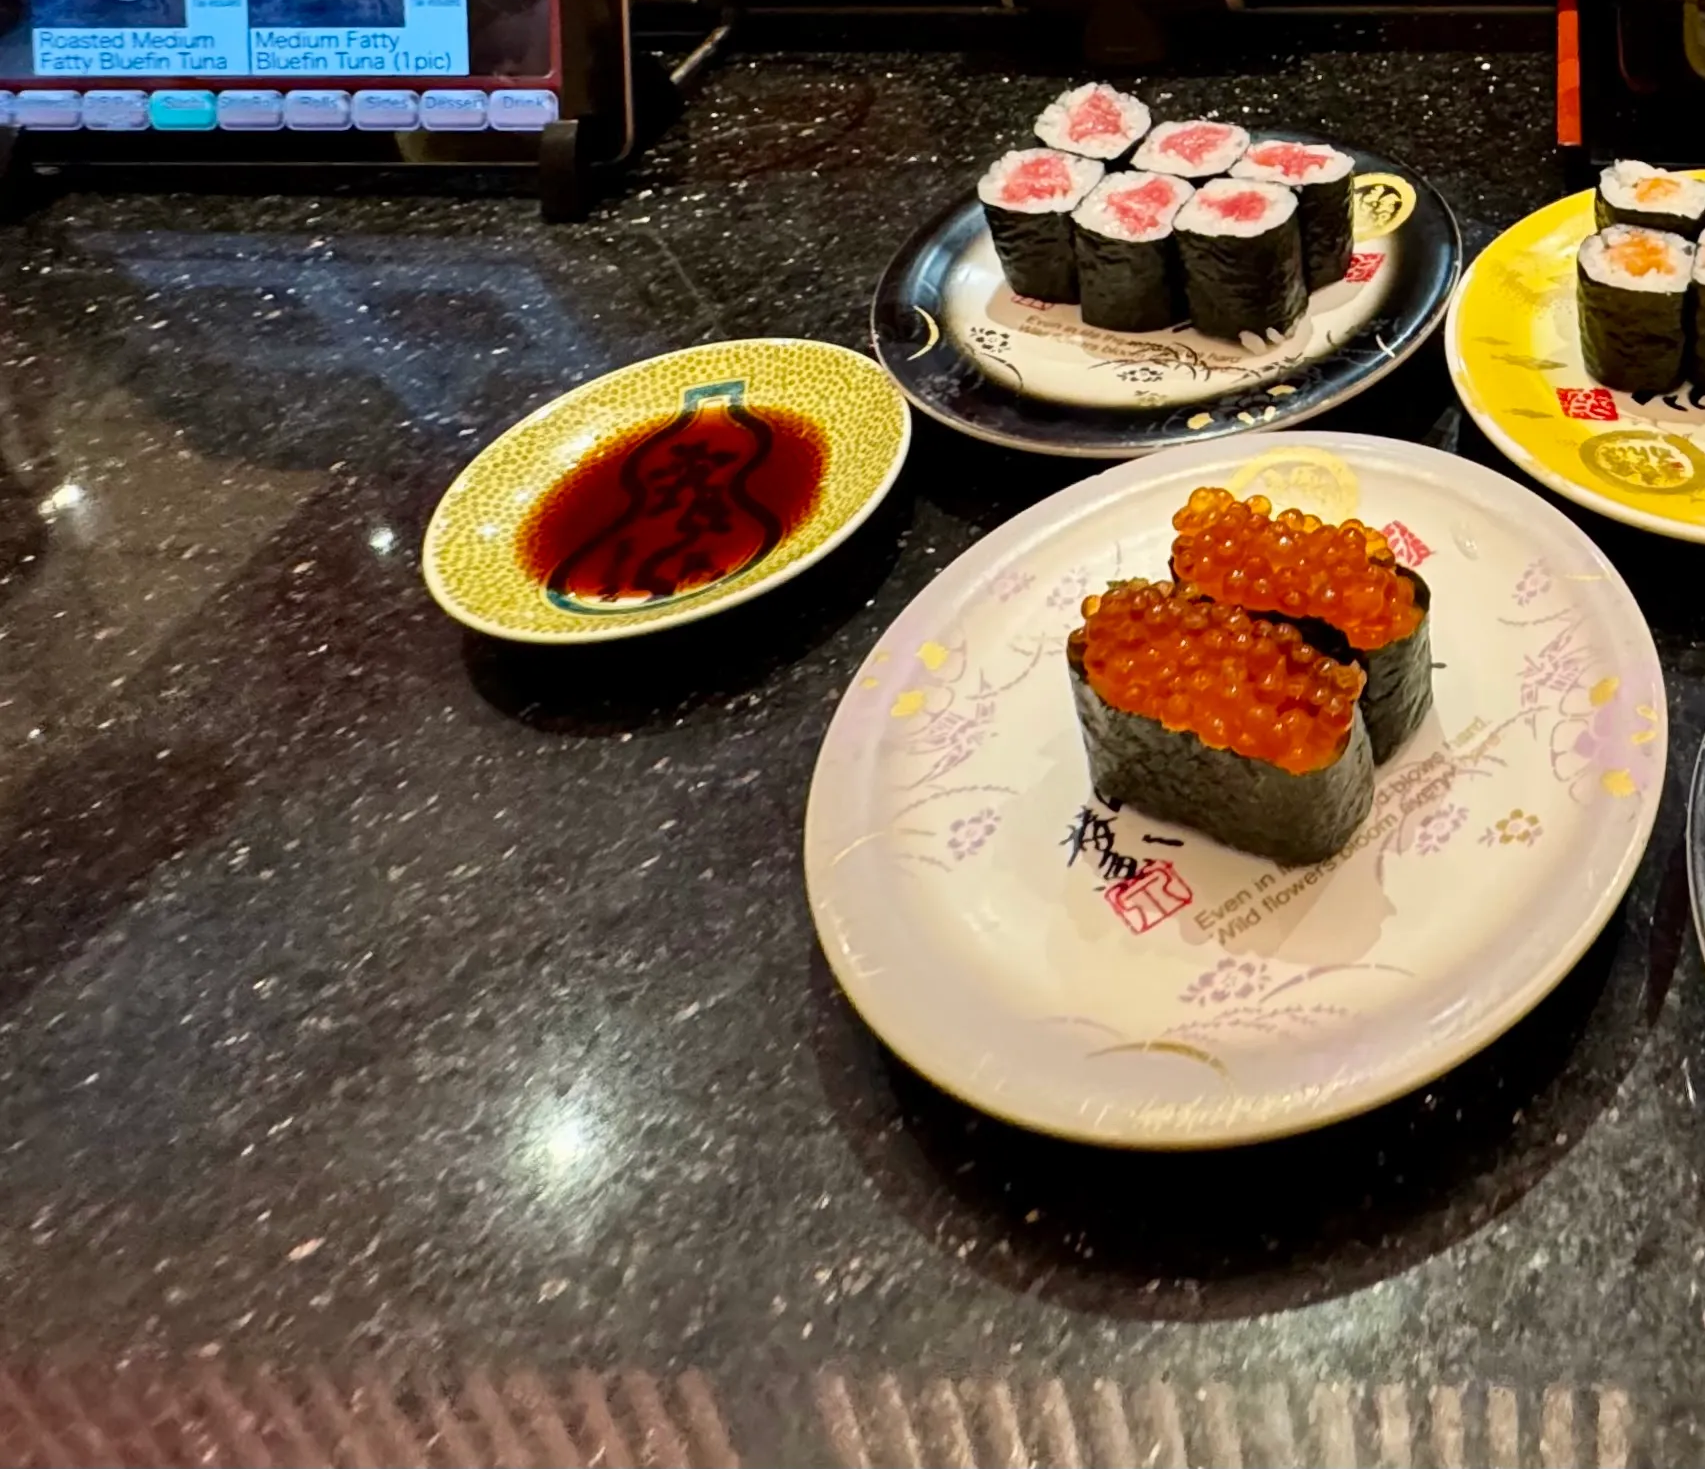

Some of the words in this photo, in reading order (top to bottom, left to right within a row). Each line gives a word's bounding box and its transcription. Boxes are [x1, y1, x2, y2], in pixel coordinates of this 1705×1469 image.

[39, 32, 124, 49] Roasted
[132, 32, 214, 49] Medium
[255, 31, 339, 49] Medium
[346, 30, 400, 53] Fatty
[40, 52, 93, 74] Fatty
[101, 51, 170, 70] Bluefin
[177, 51, 228, 70] Tuna
[257, 51, 328, 70] Bluefin
[335, 51, 385, 70] Tuna
[1194, 889, 1251, 930] Even
[1254, 872, 1276, 893] in
[1218, 907, 1261, 946] Wild
[1261, 857, 1336, 913] flowers
